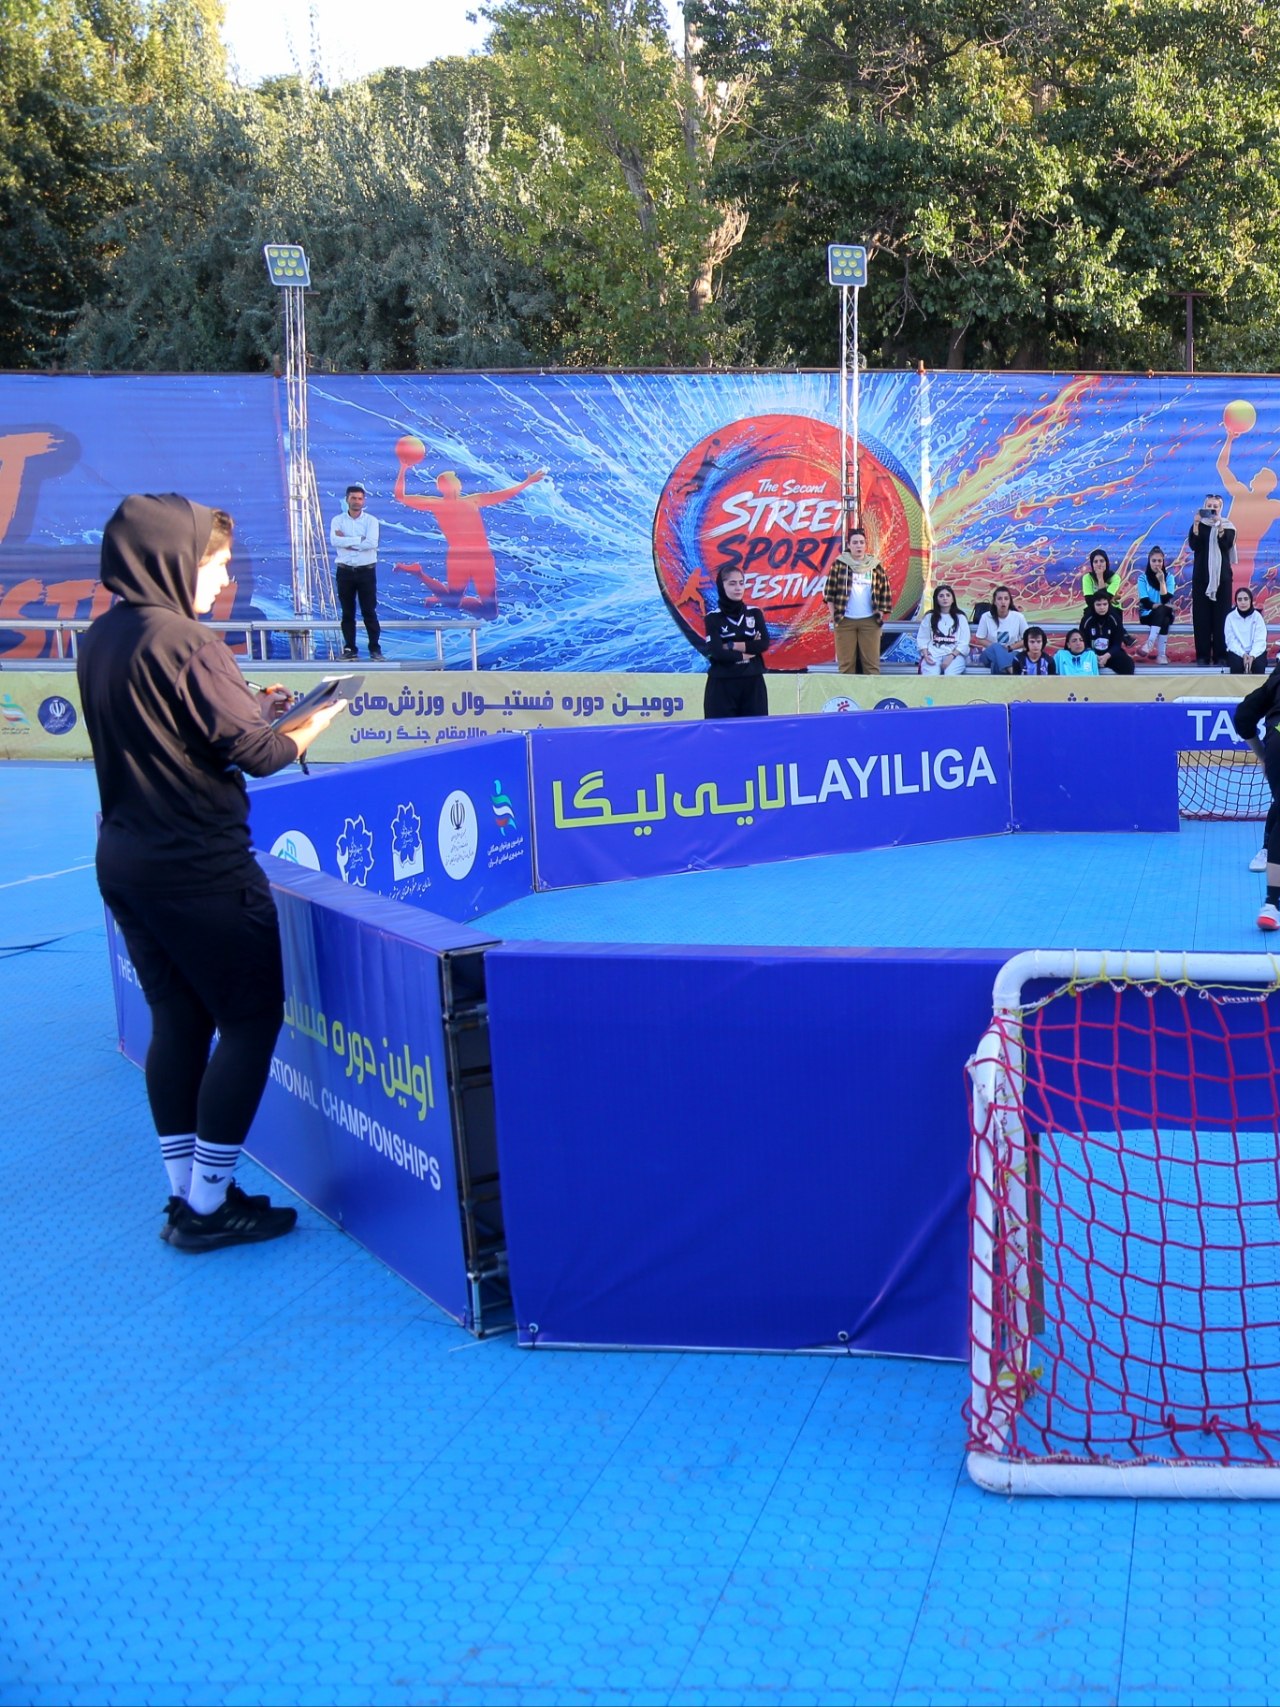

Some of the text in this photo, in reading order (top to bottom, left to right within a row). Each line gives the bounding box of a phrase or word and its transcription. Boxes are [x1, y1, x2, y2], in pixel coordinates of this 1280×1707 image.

[758, 479, 827, 495] The Second
[712, 534, 842, 573] SPORT
[744, 572, 829, 602] FESTIVA
[452, 690, 554, 717] فستیوال
[561, 696, 605, 717] دوره
[612, 695, 683, 717] دومین
[350, 726, 392, 744] رمضان
[397, 725, 431, 744] جنگ
[789, 746, 997, 805] LAYILIGA
[283, 984, 435, 1122] اولین دوره مساب
[269, 1056, 442, 1191] ATIONAL CHAMPIONSHIPS
